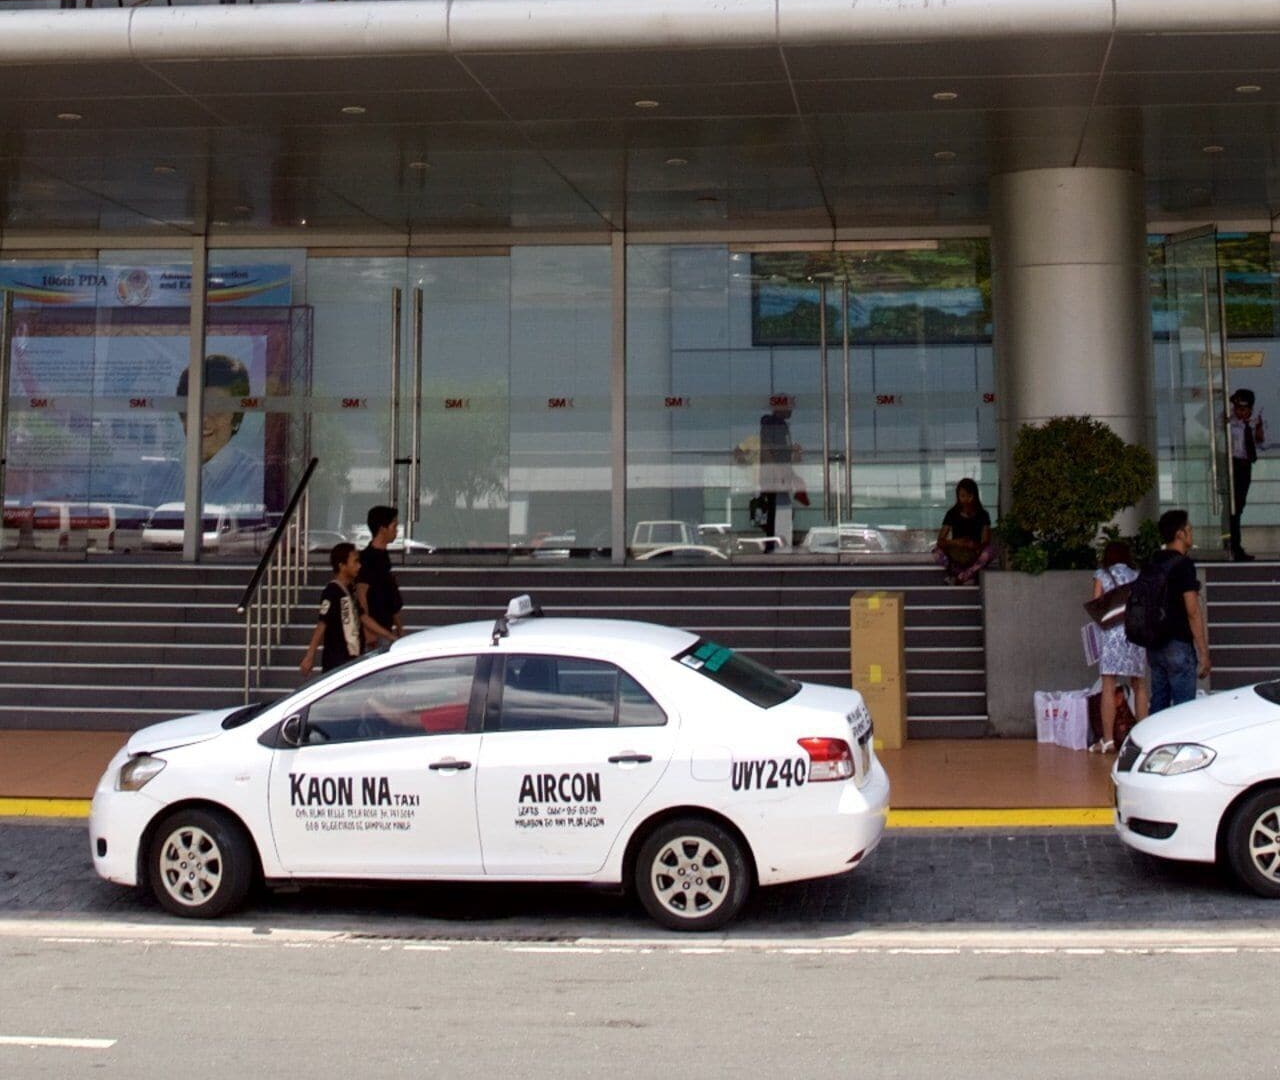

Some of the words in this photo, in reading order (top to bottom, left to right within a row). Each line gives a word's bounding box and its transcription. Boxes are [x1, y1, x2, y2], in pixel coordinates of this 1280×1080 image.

[79, 274, 108, 286] PDA
[129, 399, 154, 408] SMX
[342, 398, 368, 408] SMX
[445, 399, 470, 409] SMX
[548, 398, 574, 408] SMX
[664, 397, 690, 407] SMX
[769, 396, 796, 407] SMX
[876, 395, 903, 405] SMX
[732, 758, 806, 791] UVY240
[289, 773, 353, 806] KAON
[362, 776, 392, 806] NA
[394, 794, 420, 806] TAXI
[519, 772, 601, 803] AIRCON
